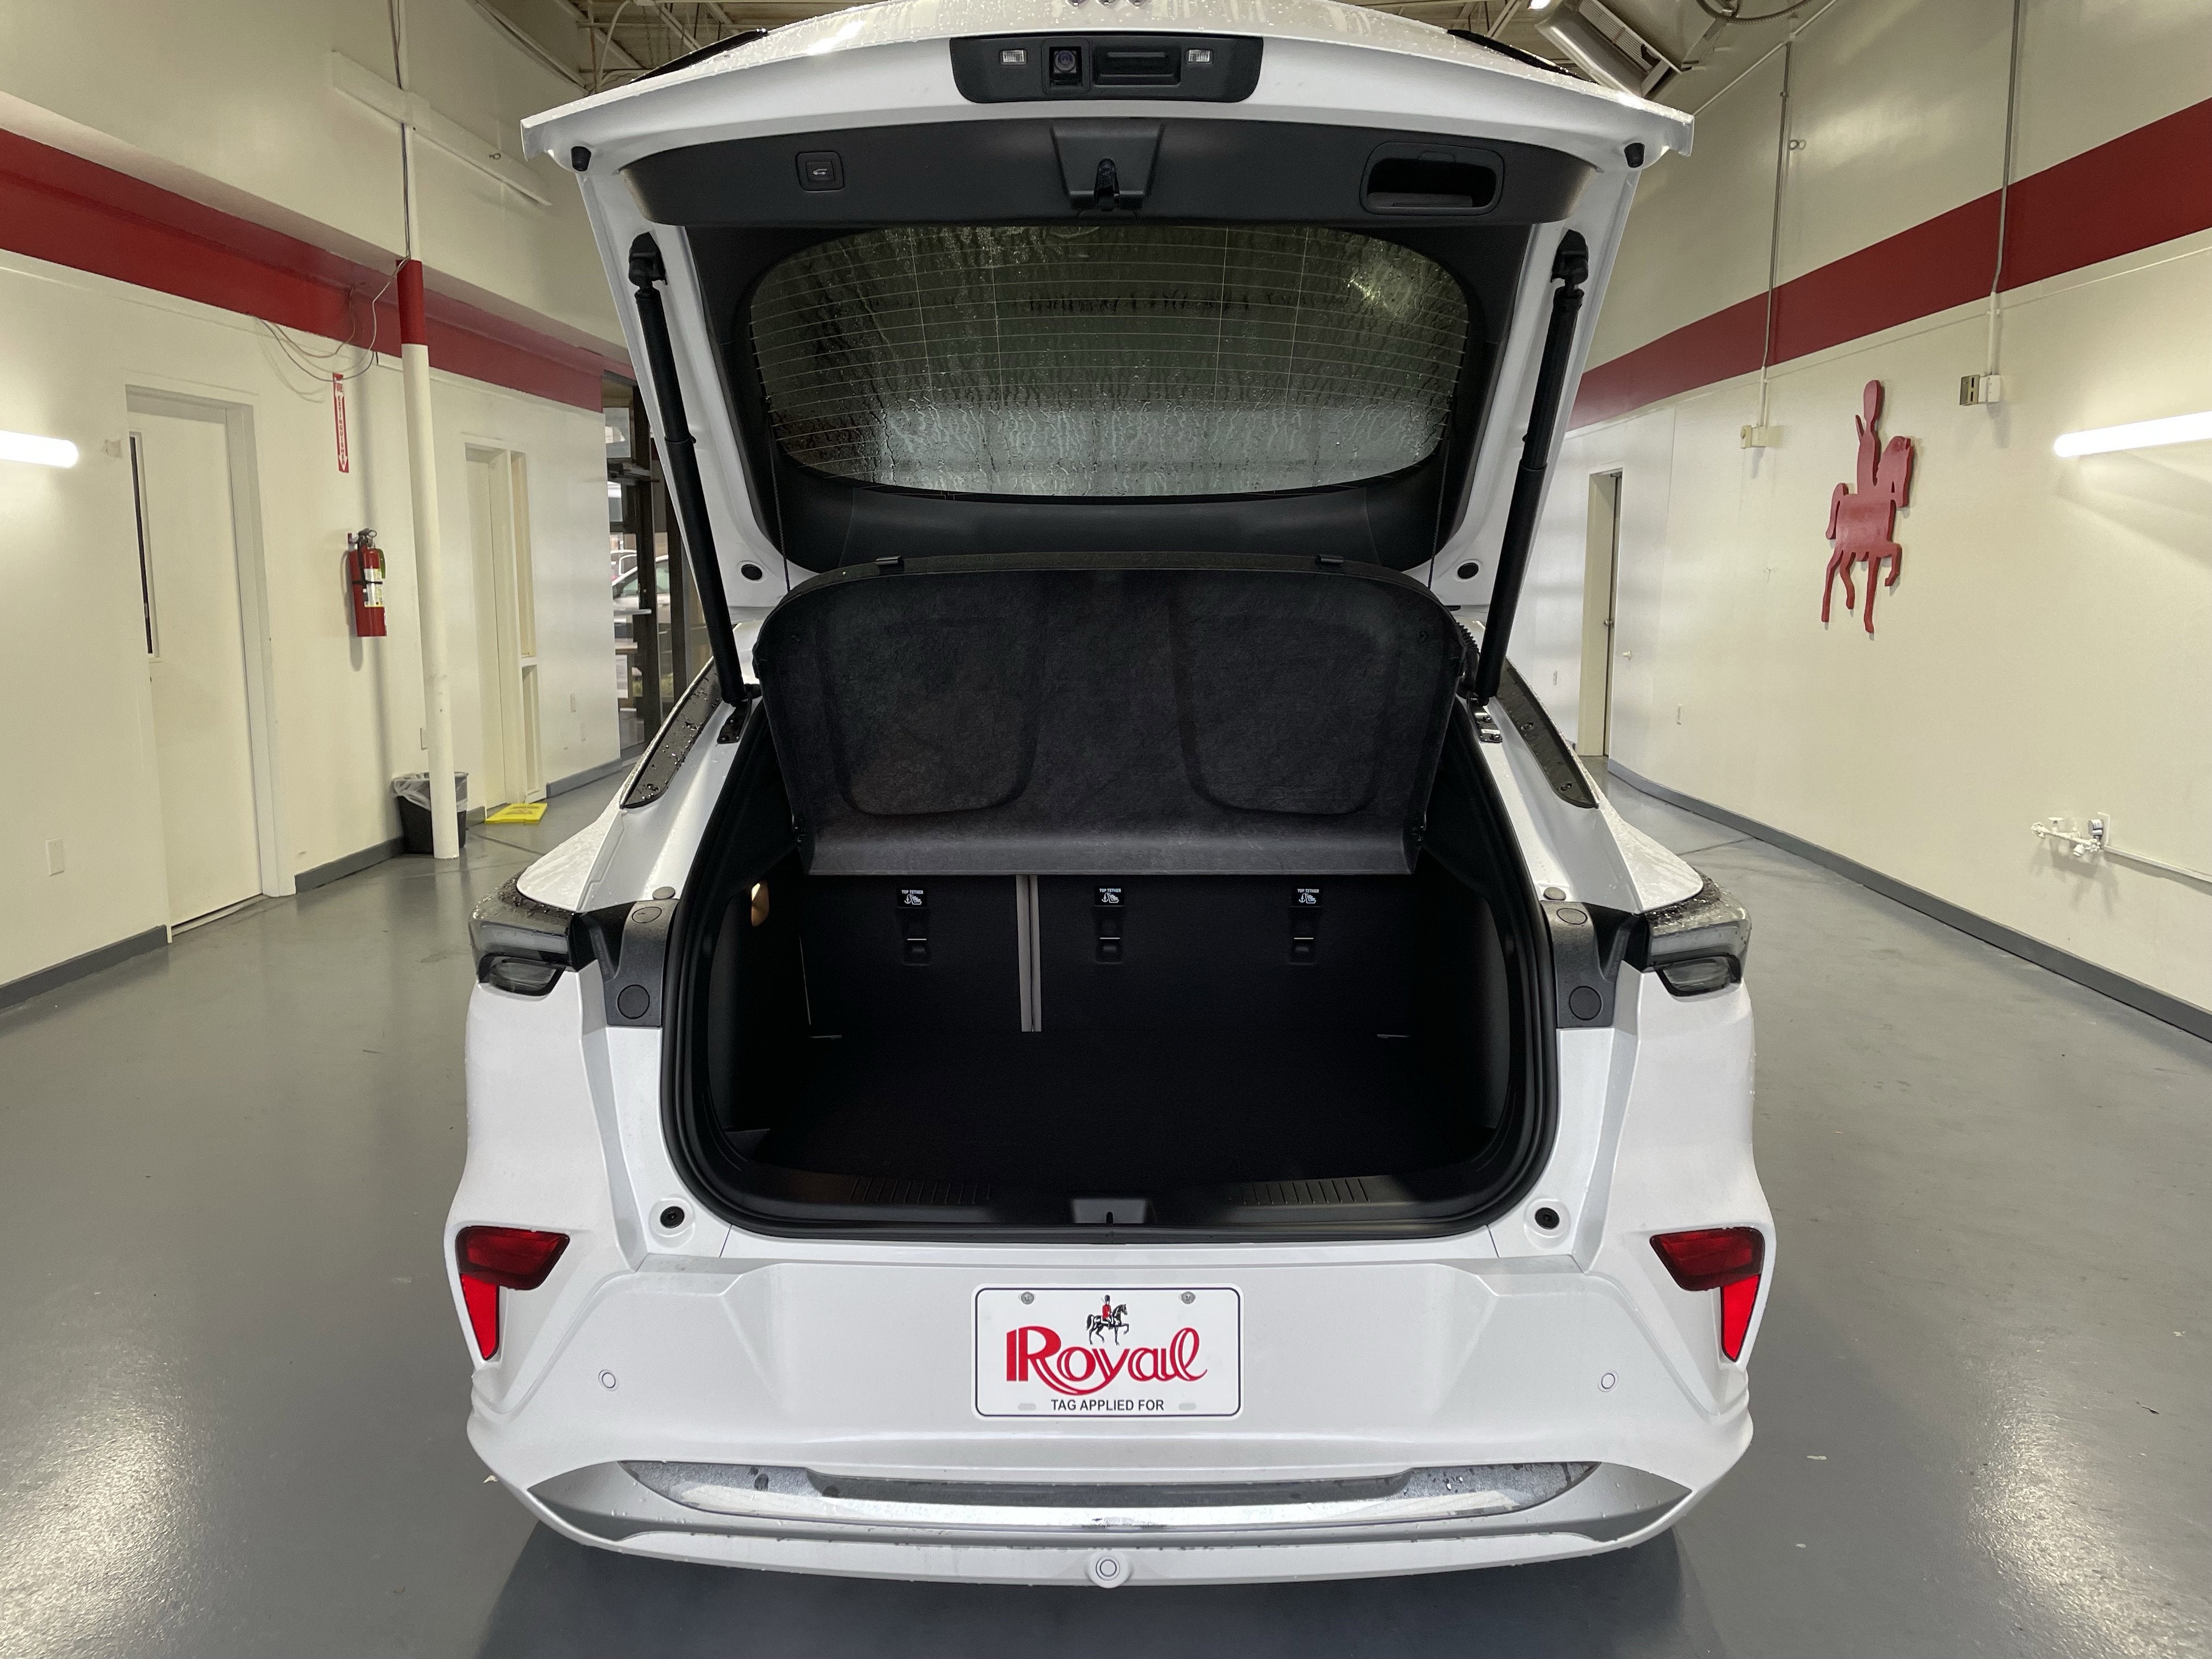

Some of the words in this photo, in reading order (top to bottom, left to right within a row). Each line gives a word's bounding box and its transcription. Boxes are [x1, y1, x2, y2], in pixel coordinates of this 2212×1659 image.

[1006, 1325, 1207, 1396] Royal
[1051, 1399, 1076, 1411] TAG
[1080, 1399, 1134, 1411] APPLIED
[1138, 1399, 1164, 1411] FOR
